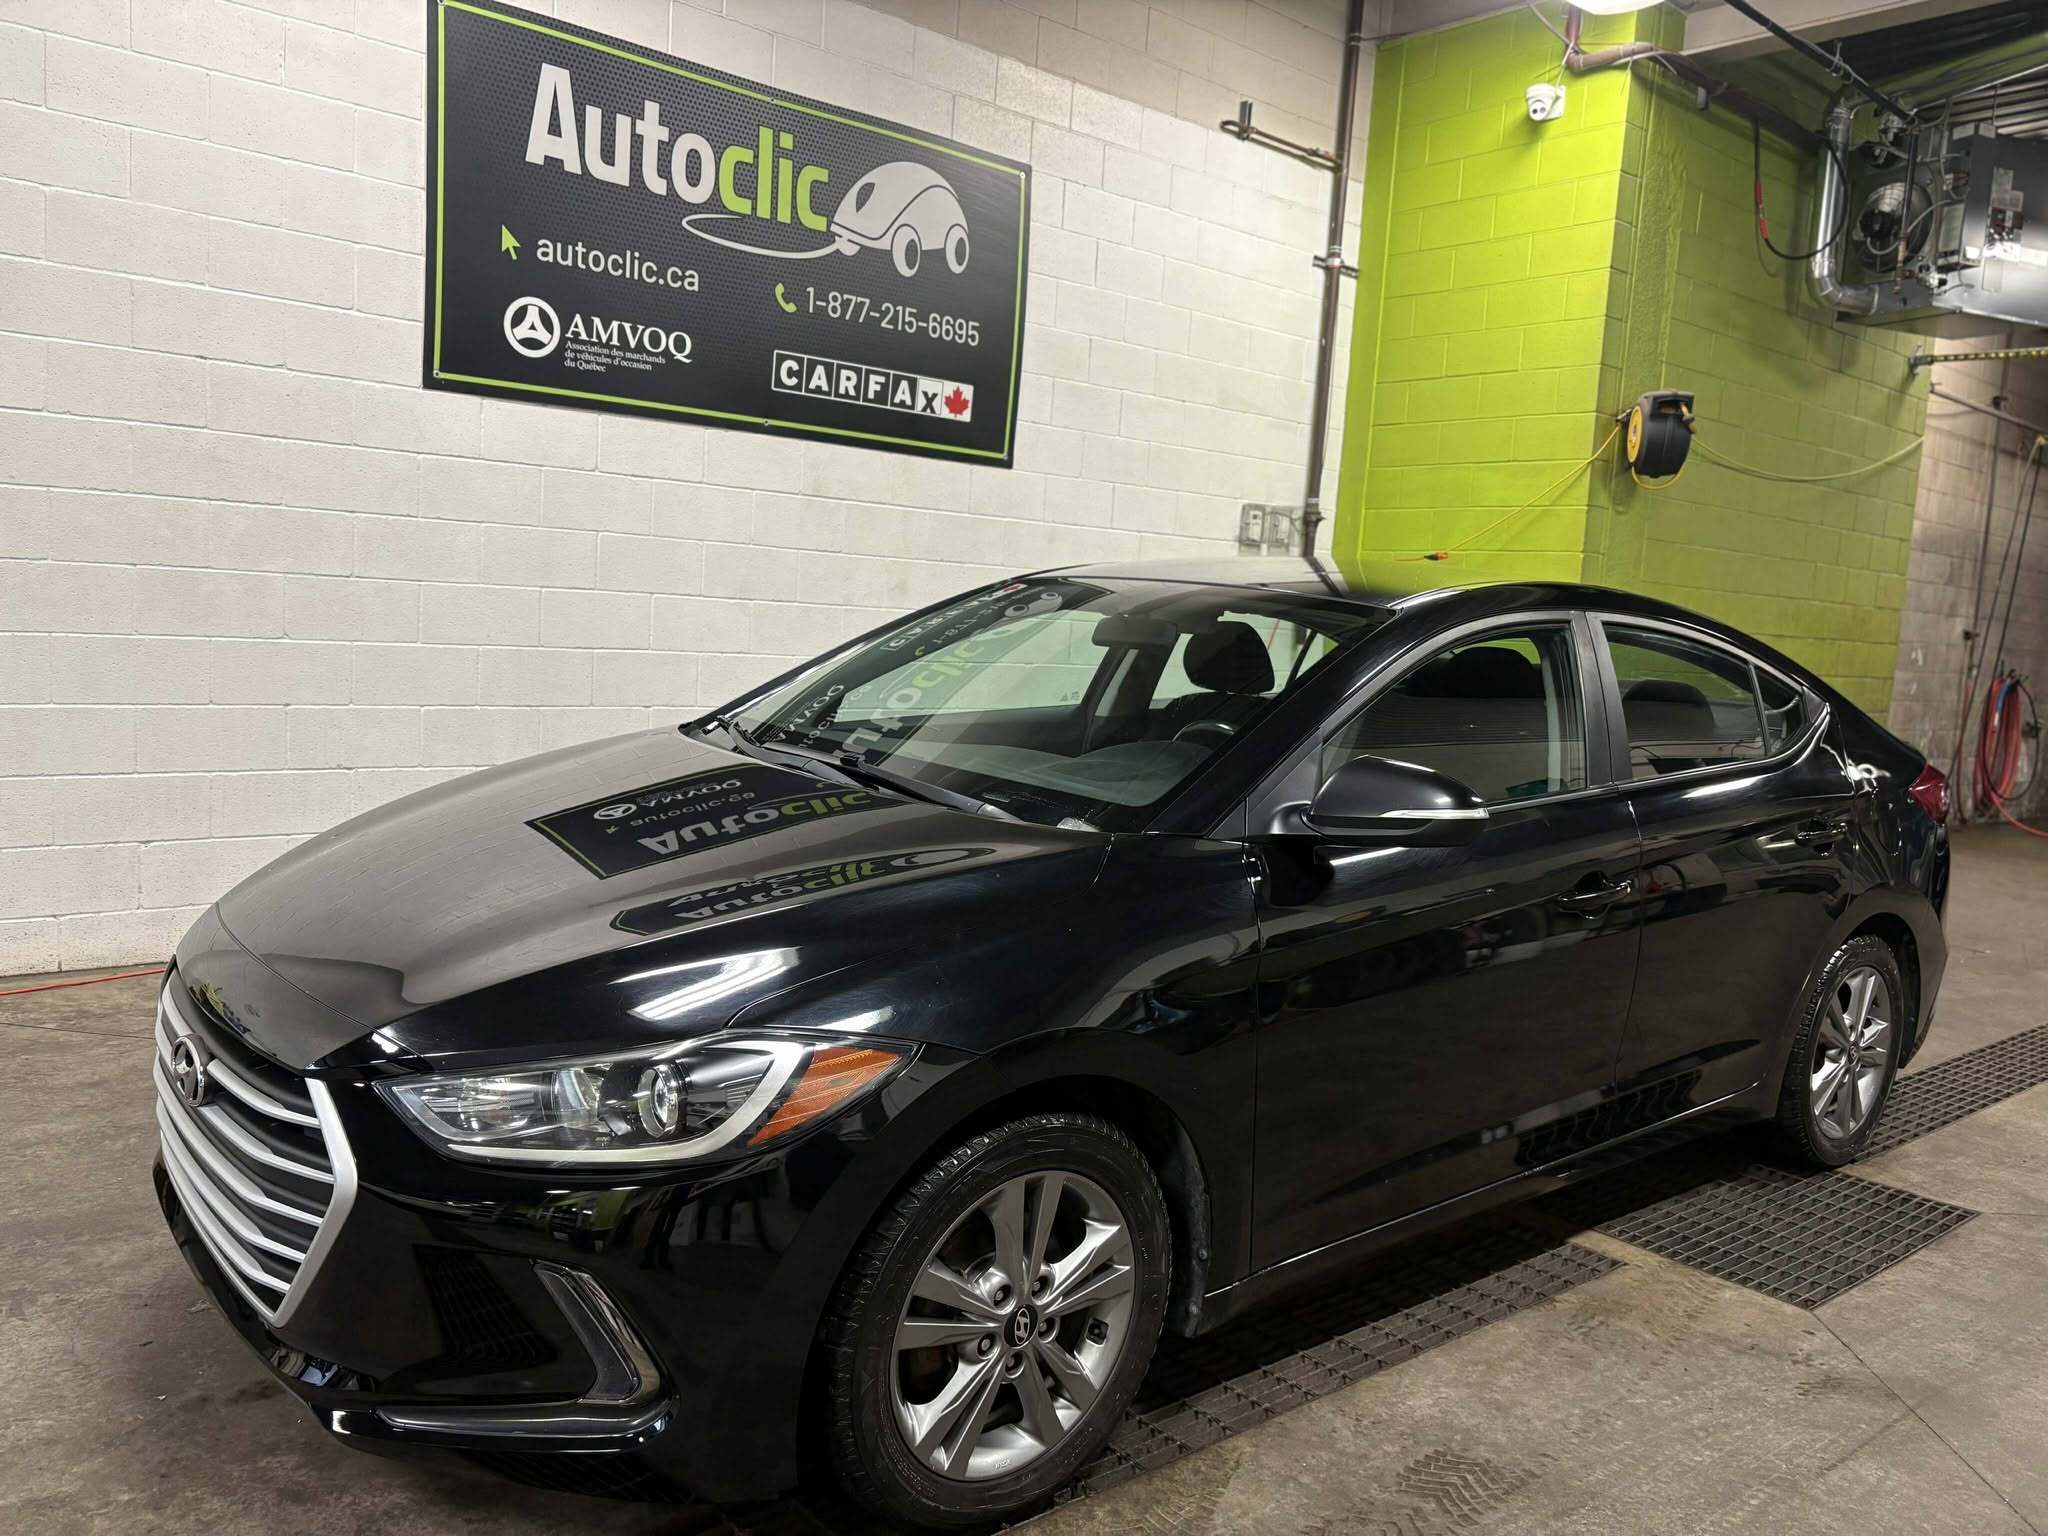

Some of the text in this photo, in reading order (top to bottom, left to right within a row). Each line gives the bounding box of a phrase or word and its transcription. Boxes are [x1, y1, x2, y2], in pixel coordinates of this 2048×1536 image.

[525, 62, 830, 232] Autoclic
[536, 235, 700, 291] autoclic.ca
[565, 313, 693, 364] AMVOQ
[806, 287, 980, 346] 1-877-215-6695
[564, 349, 652, 370] de véhicules d'occasion
[564, 359, 607, 373] du Québec
[565, 341, 666, 365] Association des marchands
[779, 359, 939, 415] CARFAX
